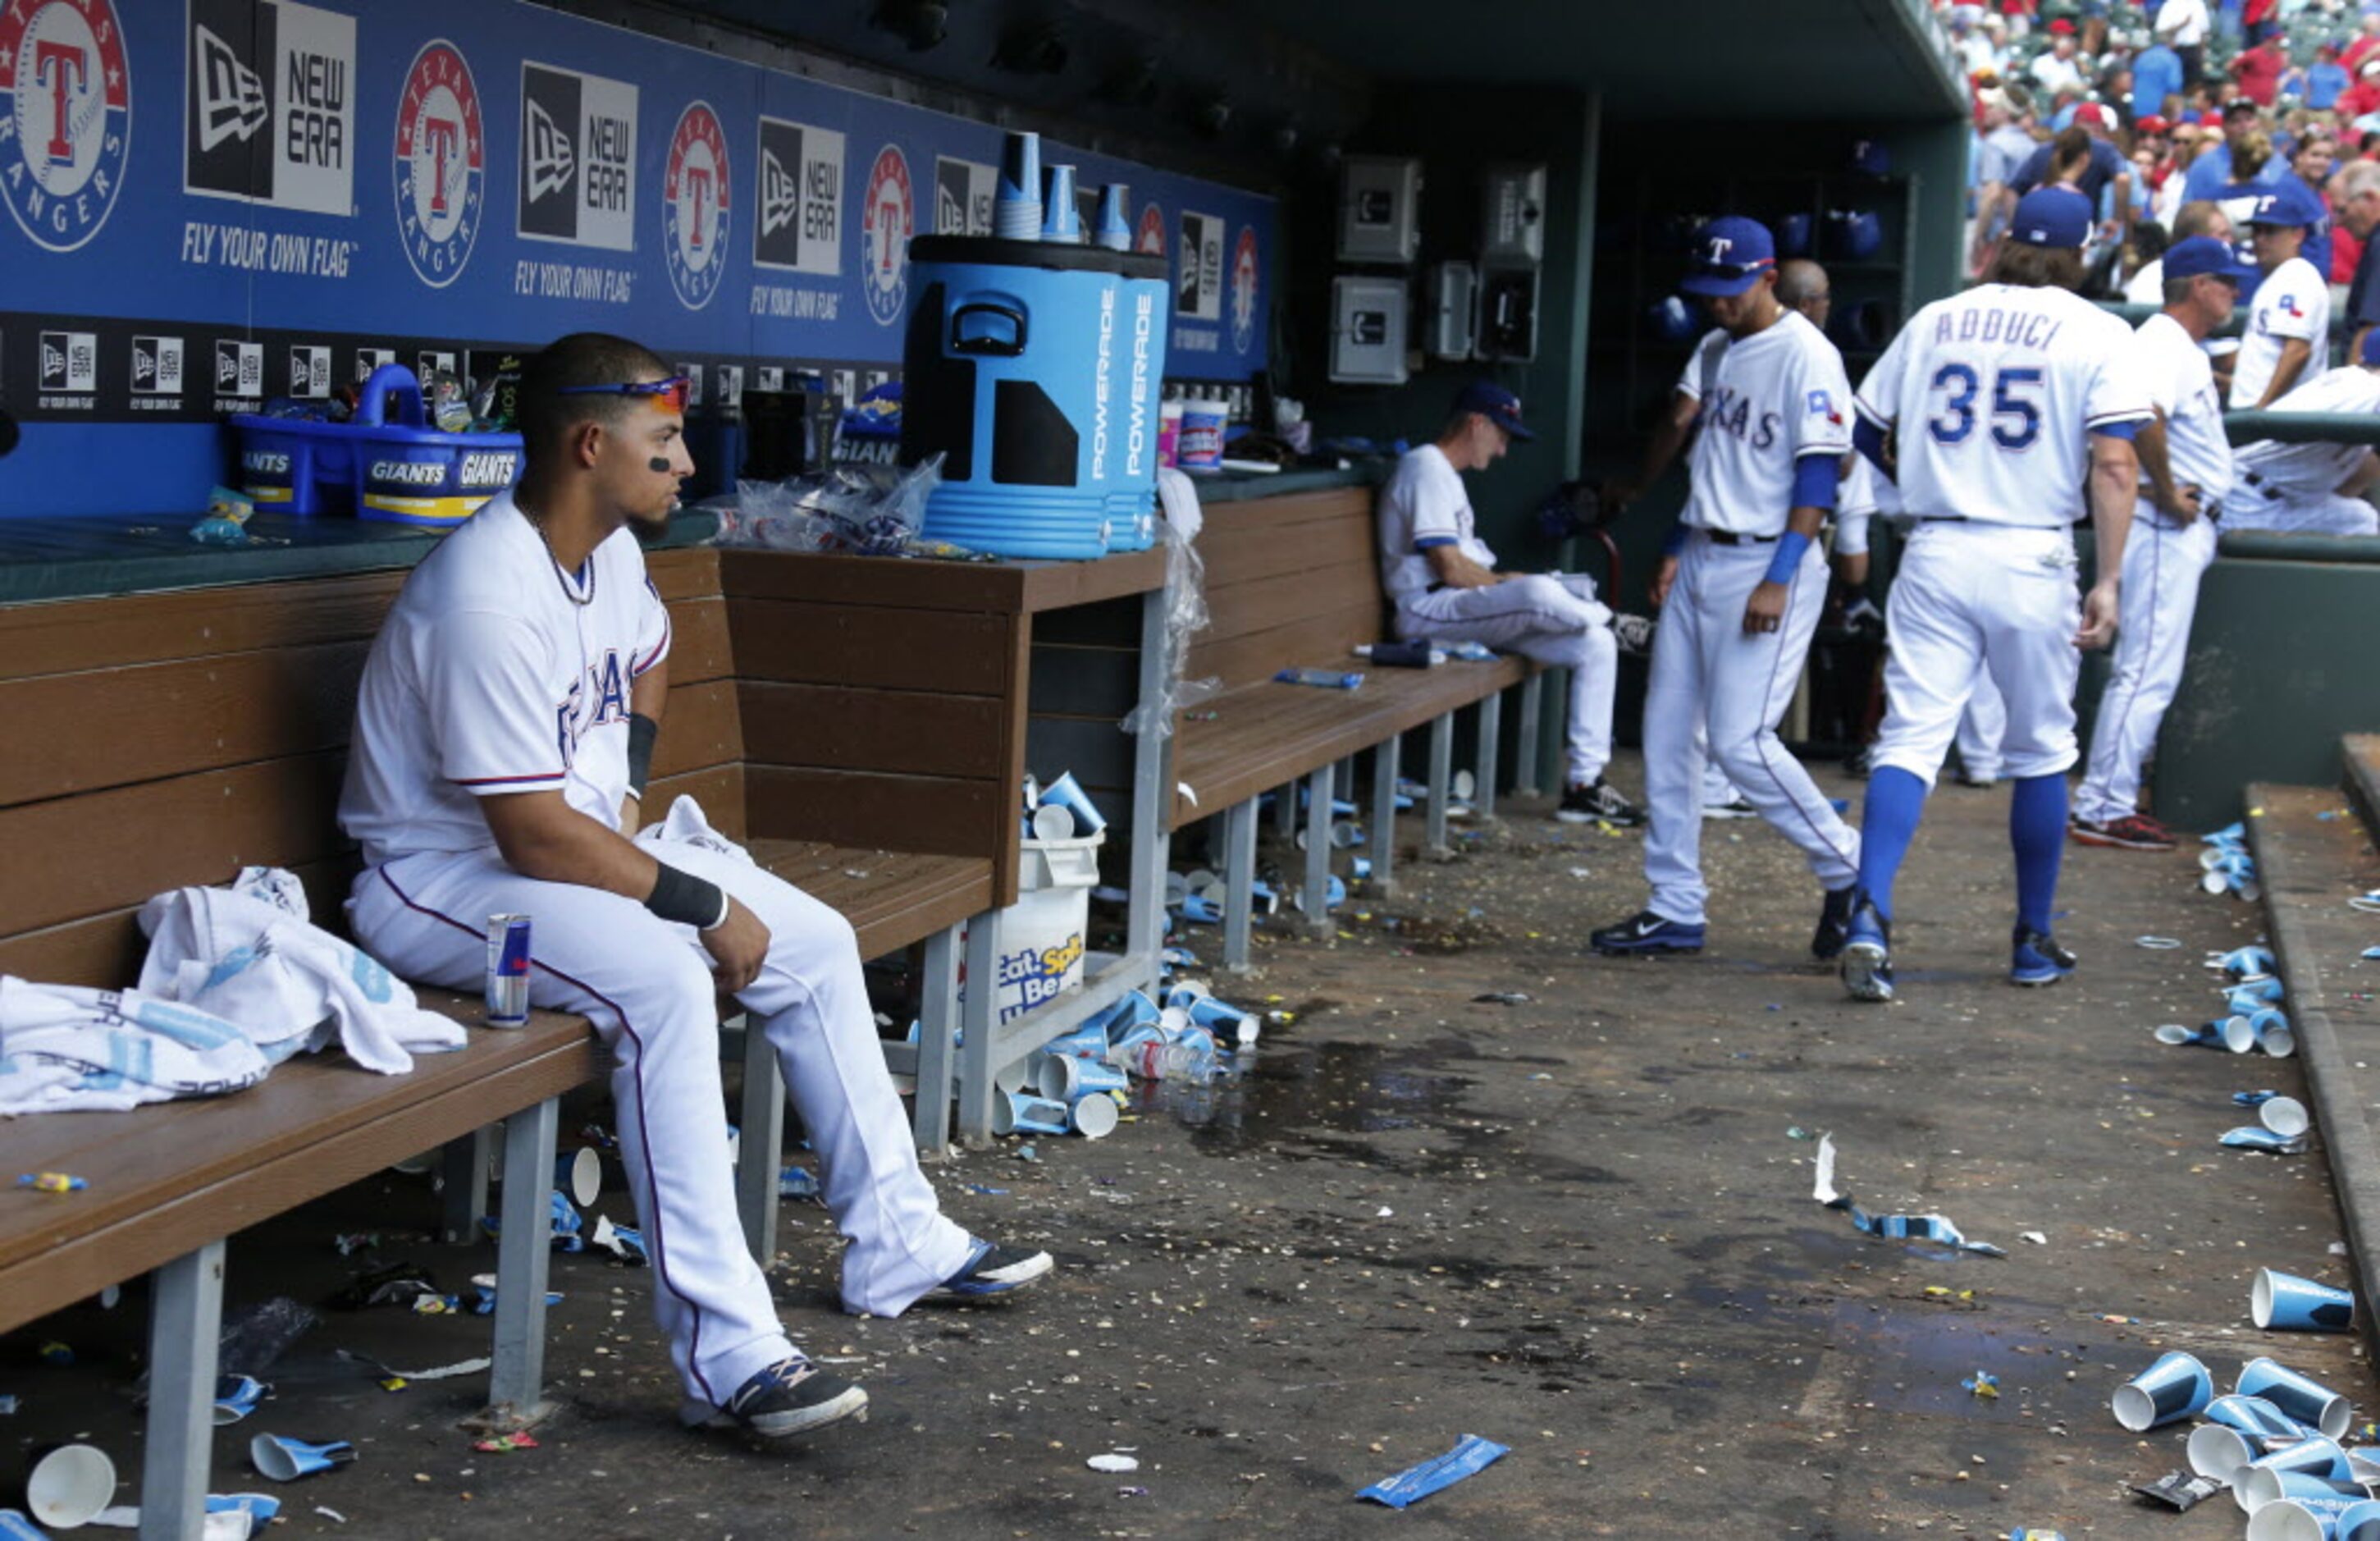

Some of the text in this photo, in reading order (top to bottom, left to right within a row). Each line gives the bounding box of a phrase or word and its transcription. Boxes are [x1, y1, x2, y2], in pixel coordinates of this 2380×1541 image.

[37, 39, 86, 167] T
[288, 49, 345, 112] NEW
[409, 54, 473, 118] TEXAS
[287, 108, 342, 170] ERA
[588, 113, 628, 164] NEW
[425, 116, 458, 219] T
[587, 163, 627, 213] ERA
[806, 158, 838, 202] NEW
[400, 176, 477, 273] RANGERS
[687, 166, 710, 252] T
[805, 202, 836, 242] ERA
[181, 222, 216, 264] FLY
[219, 225, 267, 271] YOUR
[269, 233, 311, 275] OWN
[1710, 237, 1733, 266] T
[515, 259, 539, 296] FLY
[540, 262, 573, 299] YOUR
[573, 265, 604, 302] OWN
[750, 285, 770, 316] FLY
[770, 286, 794, 318] YOUR
[794, 289, 816, 320] OWN
[1935, 308, 2063, 352] ADDUCI
[1092, 288, 1115, 480] POWERADE
[1126, 294, 1152, 476] POWERADE
[1928, 359, 2046, 454] 35
[1702, 386, 1781, 450] EXAS
[371, 460, 445, 486] GIANTS
[460, 455, 516, 485] GIANTS
[834, 437, 900, 465] GIAN
